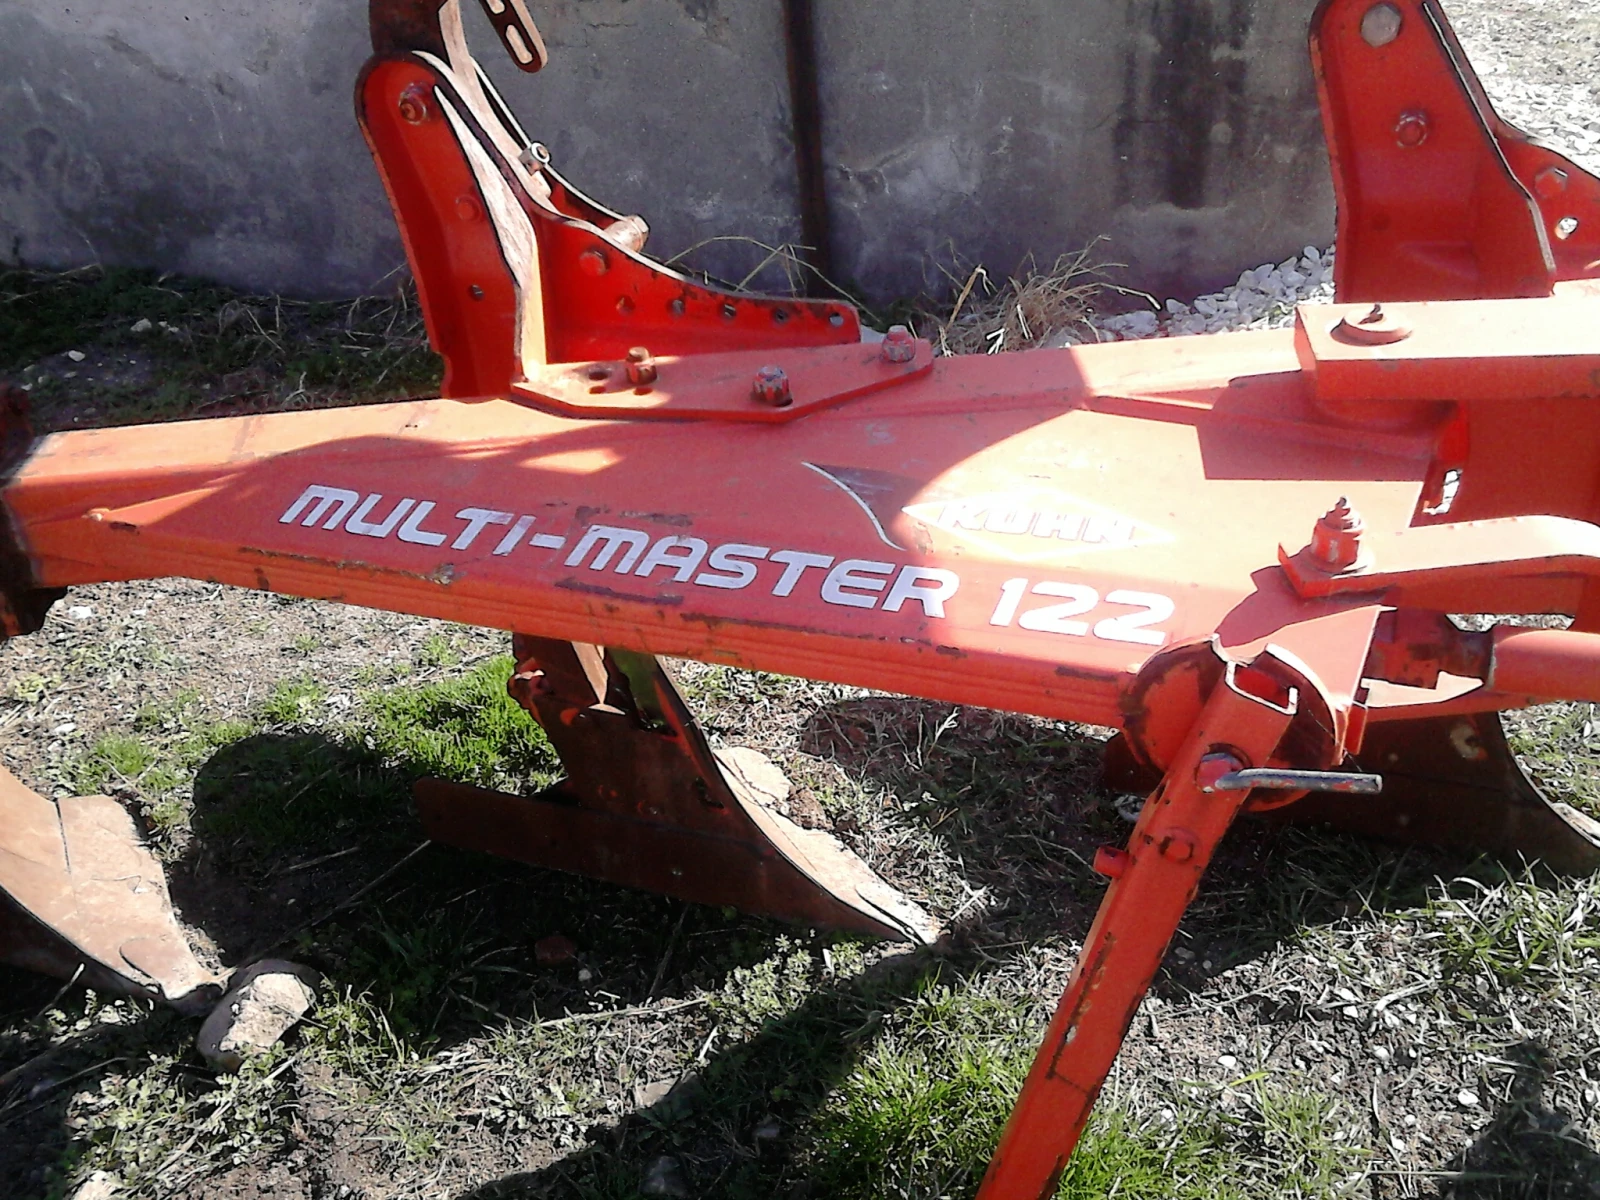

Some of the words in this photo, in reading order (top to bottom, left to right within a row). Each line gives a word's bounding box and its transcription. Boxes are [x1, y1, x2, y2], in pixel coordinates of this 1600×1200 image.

[279, 484, 960, 619] MULTI-MASTER
[989, 577, 1176, 646] 122
[937, 502, 1137, 544] KUHN
